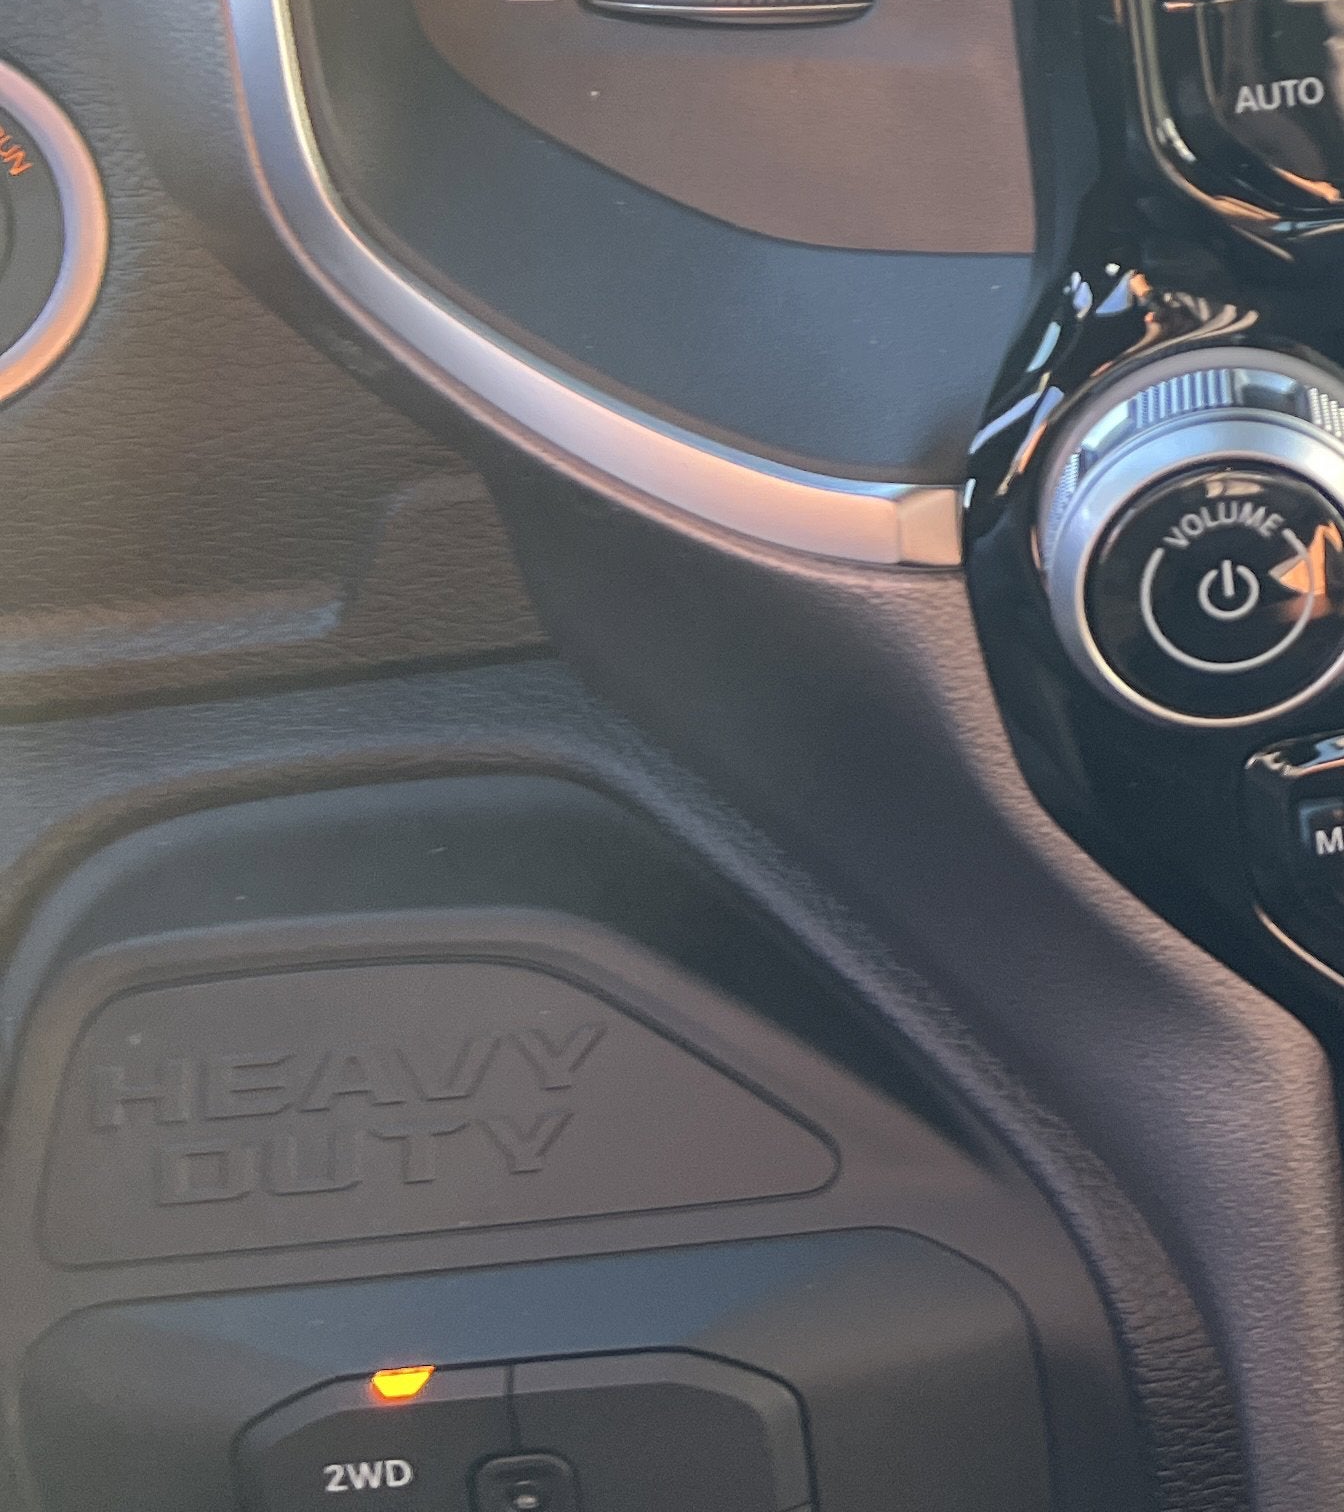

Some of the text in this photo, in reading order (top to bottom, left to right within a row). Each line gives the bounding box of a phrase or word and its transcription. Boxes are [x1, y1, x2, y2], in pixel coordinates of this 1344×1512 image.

[1236, 77, 1324, 113] AUTO
[0, 124, 33, 176] UN
[1163, 500, 1284, 550] VOLUME
[88, 1025, 605, 1132] HEAVY
[155, 1112, 573, 1206] DUTY
[323, 1458, 413, 1492] 2WD
